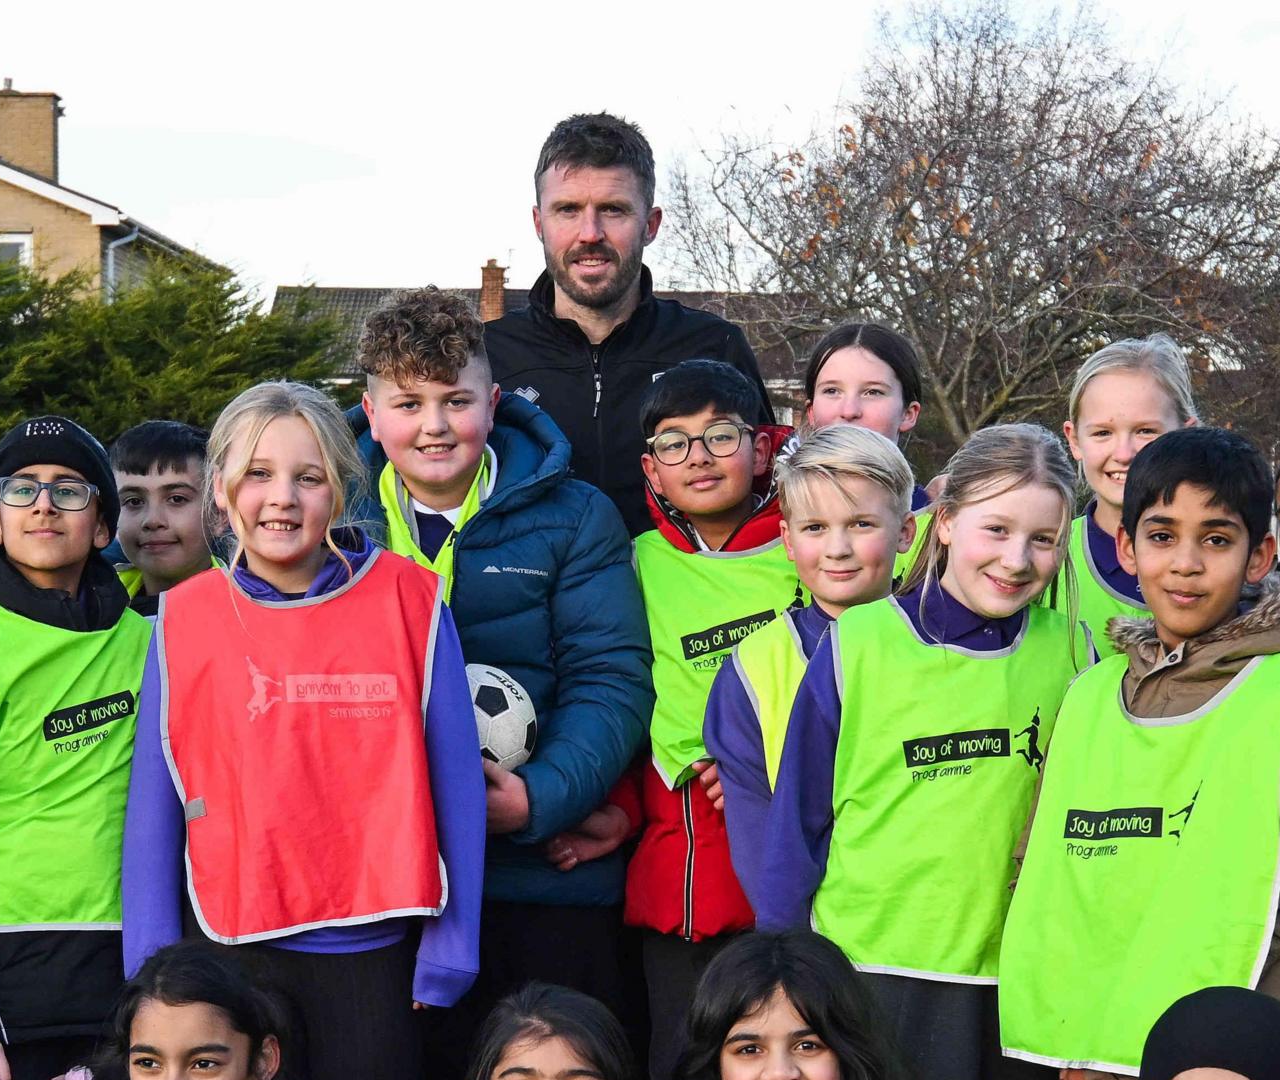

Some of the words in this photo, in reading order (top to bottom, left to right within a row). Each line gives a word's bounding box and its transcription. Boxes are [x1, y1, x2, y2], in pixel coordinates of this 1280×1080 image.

[688, 638, 710, 654] Joy
[712, 630, 724, 647] of
[50, 717, 74, 735] Joy
[76, 708, 87, 726] of
[90, 700, 129, 723] moving
[53, 729, 109, 755] Programme
[912, 744, 936, 763] Joy
[940, 739, 954, 756] of
[958, 734, 1002, 754] moving
[912, 764, 972, 783] Programme
[1069, 816, 1095, 838] Joy
[1109, 813, 1153, 834] moving
[1066, 842, 1118, 860] Programme
